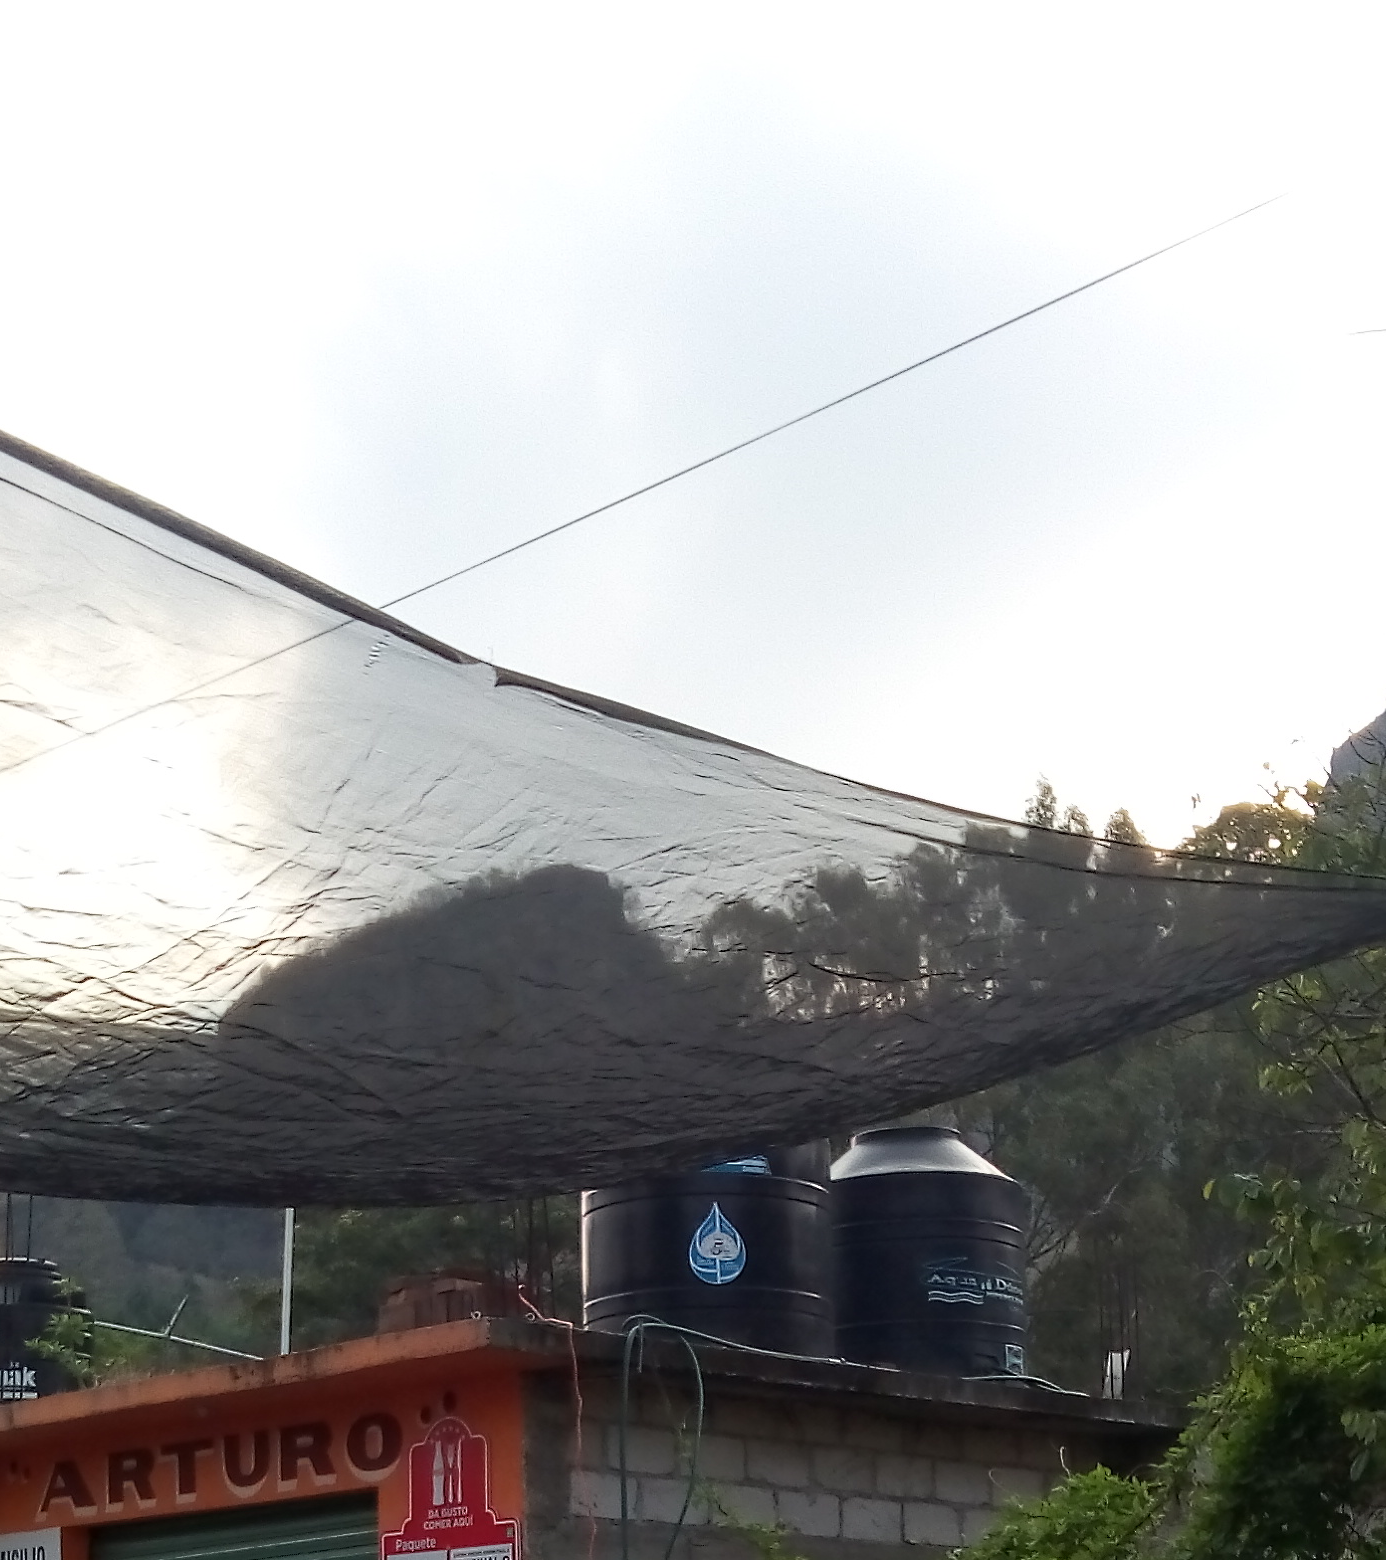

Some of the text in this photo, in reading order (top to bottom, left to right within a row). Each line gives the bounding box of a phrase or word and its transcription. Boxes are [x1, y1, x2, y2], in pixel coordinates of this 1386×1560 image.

[441, 1506, 468, 1518] GUSTO
[423, 1518, 452, 1530] COMER
[395, 1537, 437, 1552] Paquete
